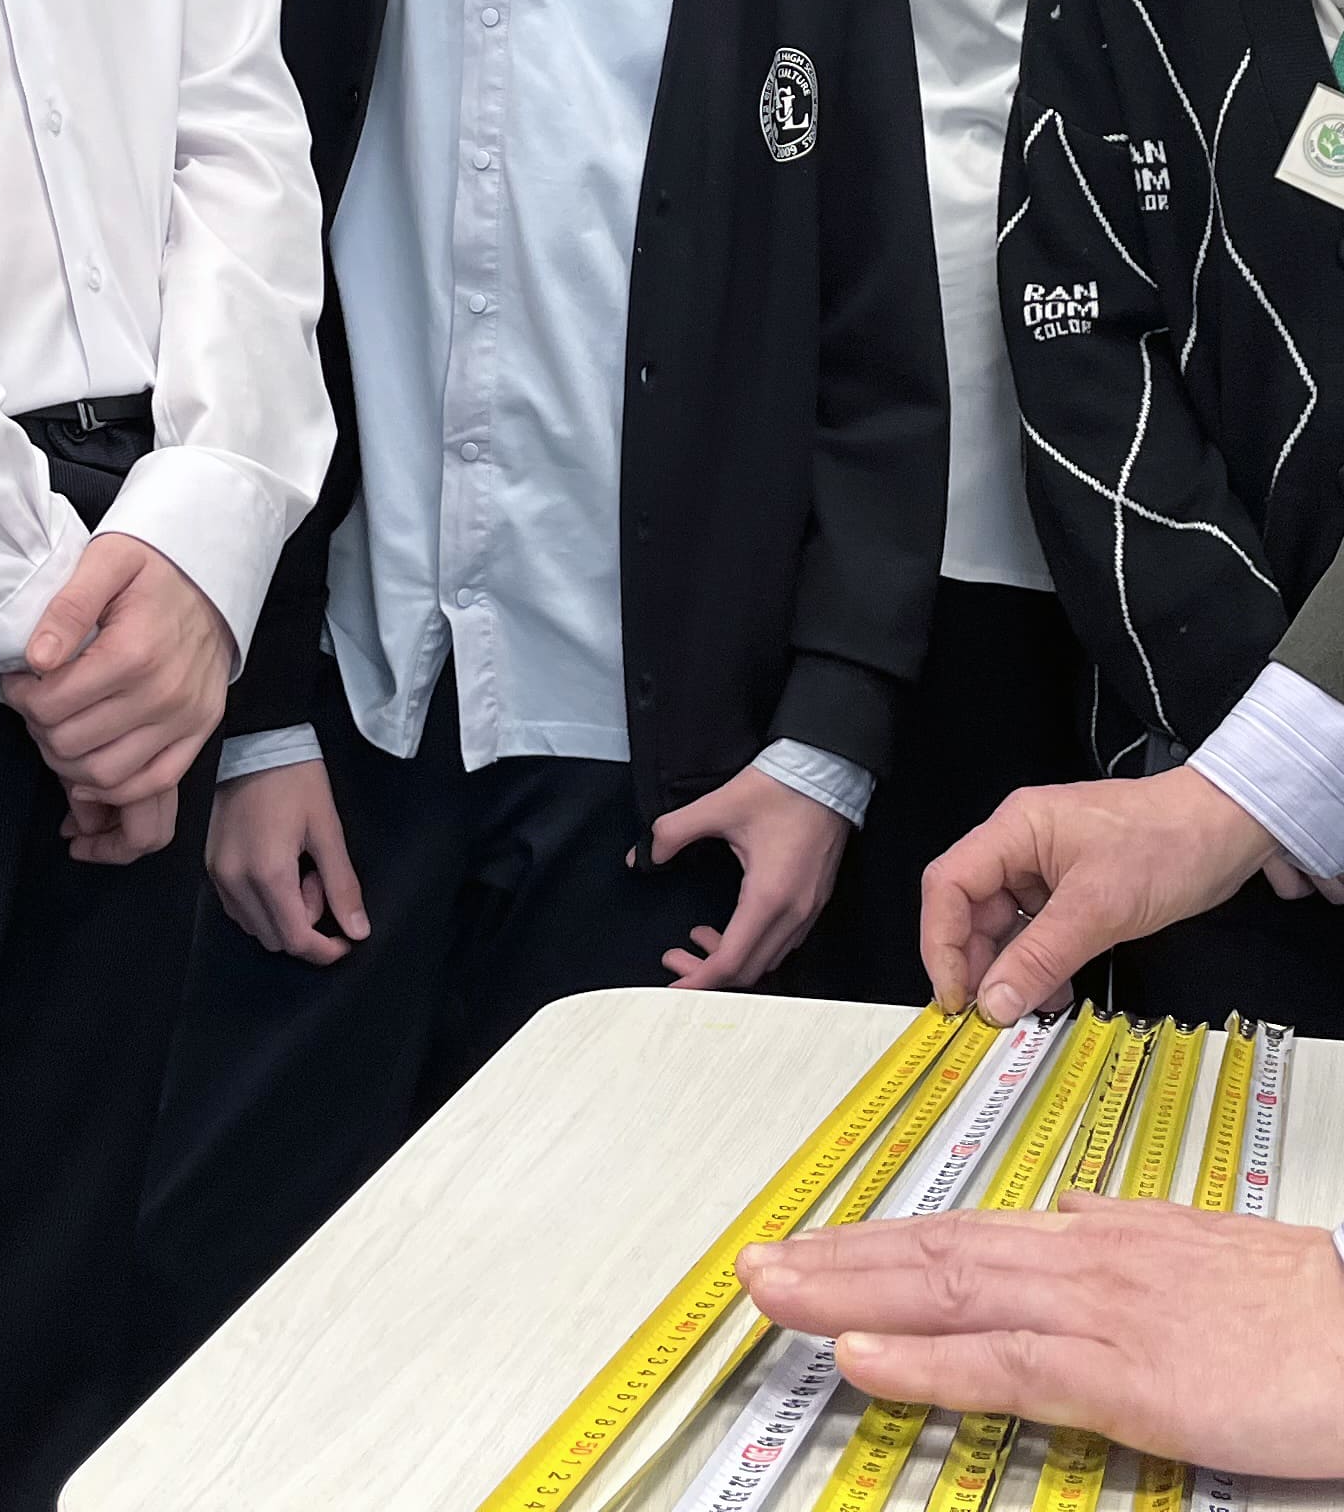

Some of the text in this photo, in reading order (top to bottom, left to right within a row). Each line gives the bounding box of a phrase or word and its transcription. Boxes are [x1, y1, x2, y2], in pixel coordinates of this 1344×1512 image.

[781, 52, 805, 65] HIGH
[777, 68, 811, 97] CULTURE
[1023, 281, 1098, 302] RAN
[1033, 319, 1092, 341] COLOR
